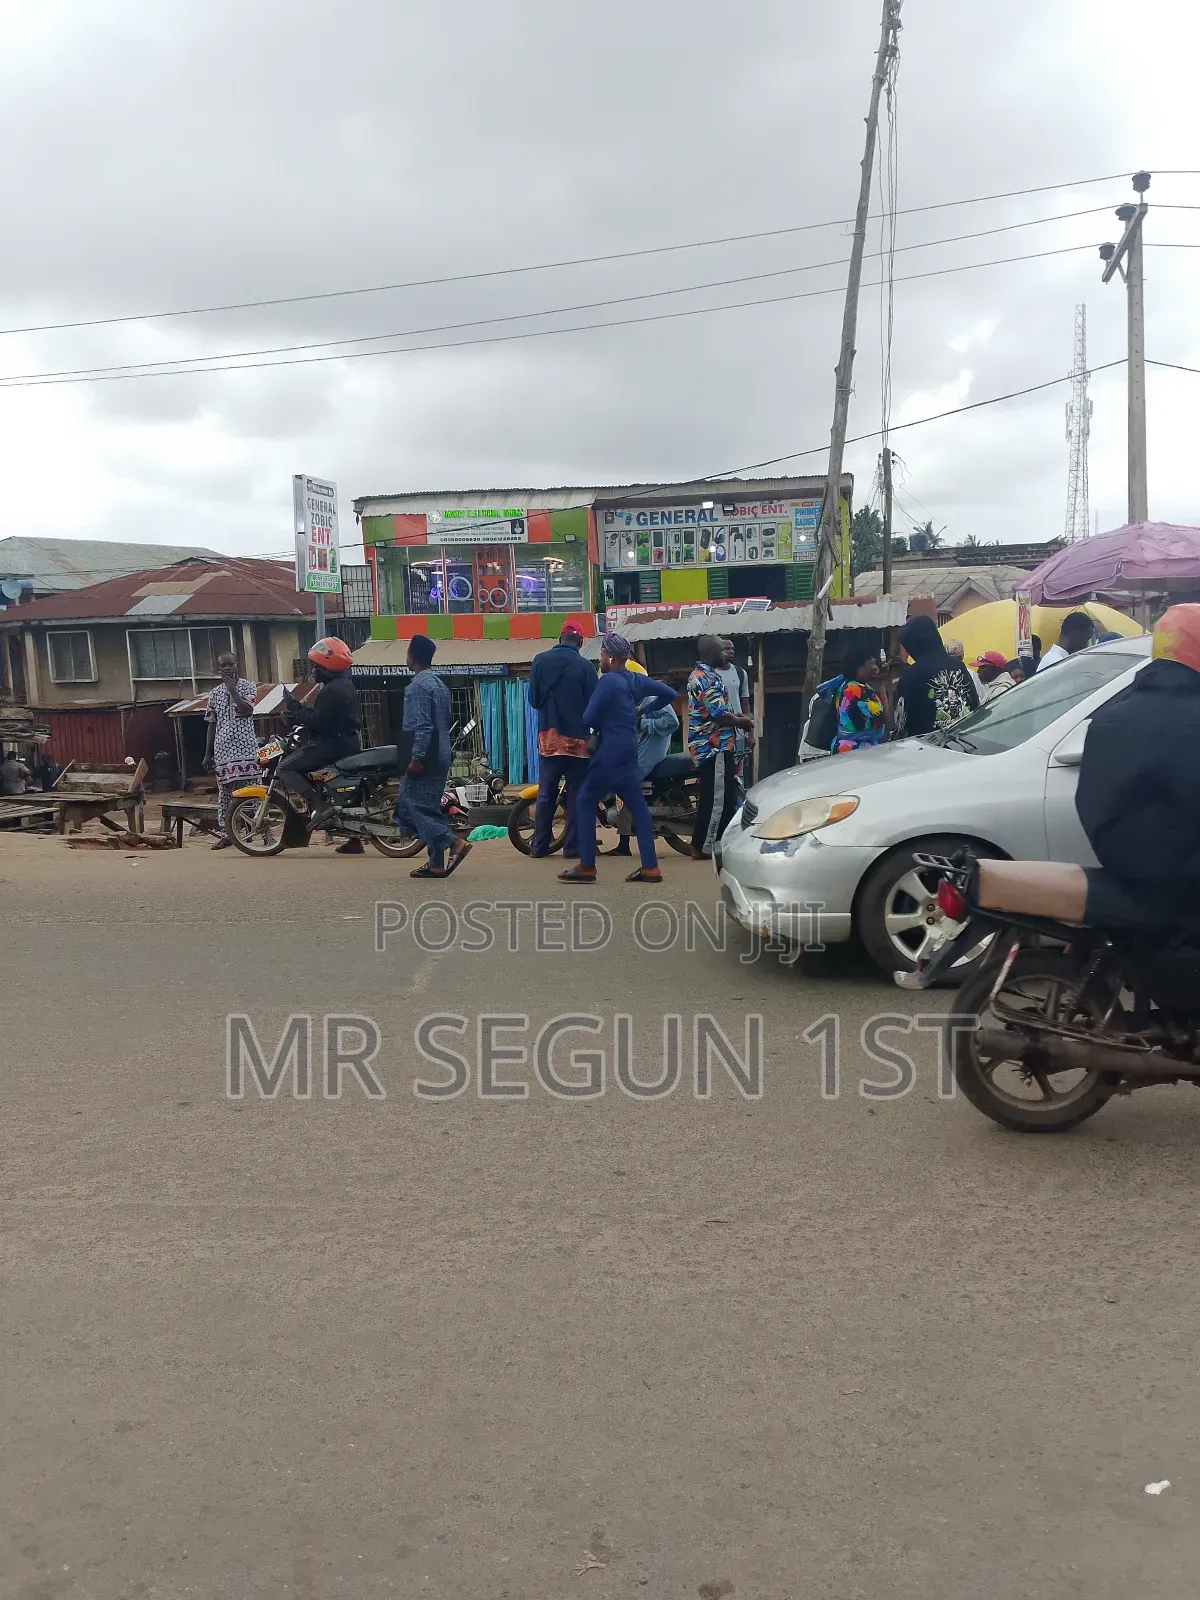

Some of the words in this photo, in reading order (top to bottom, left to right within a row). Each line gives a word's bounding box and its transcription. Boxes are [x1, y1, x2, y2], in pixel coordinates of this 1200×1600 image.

[307, 497, 336, 515] GENERAL
[635, 508, 719, 527] GENERAL
[761, 503, 788, 515] ENT.
[311, 512, 333, 528] ZOBIC
[311, 525, 333, 546] ENT.
[351, 666, 382, 676] HOWDY
